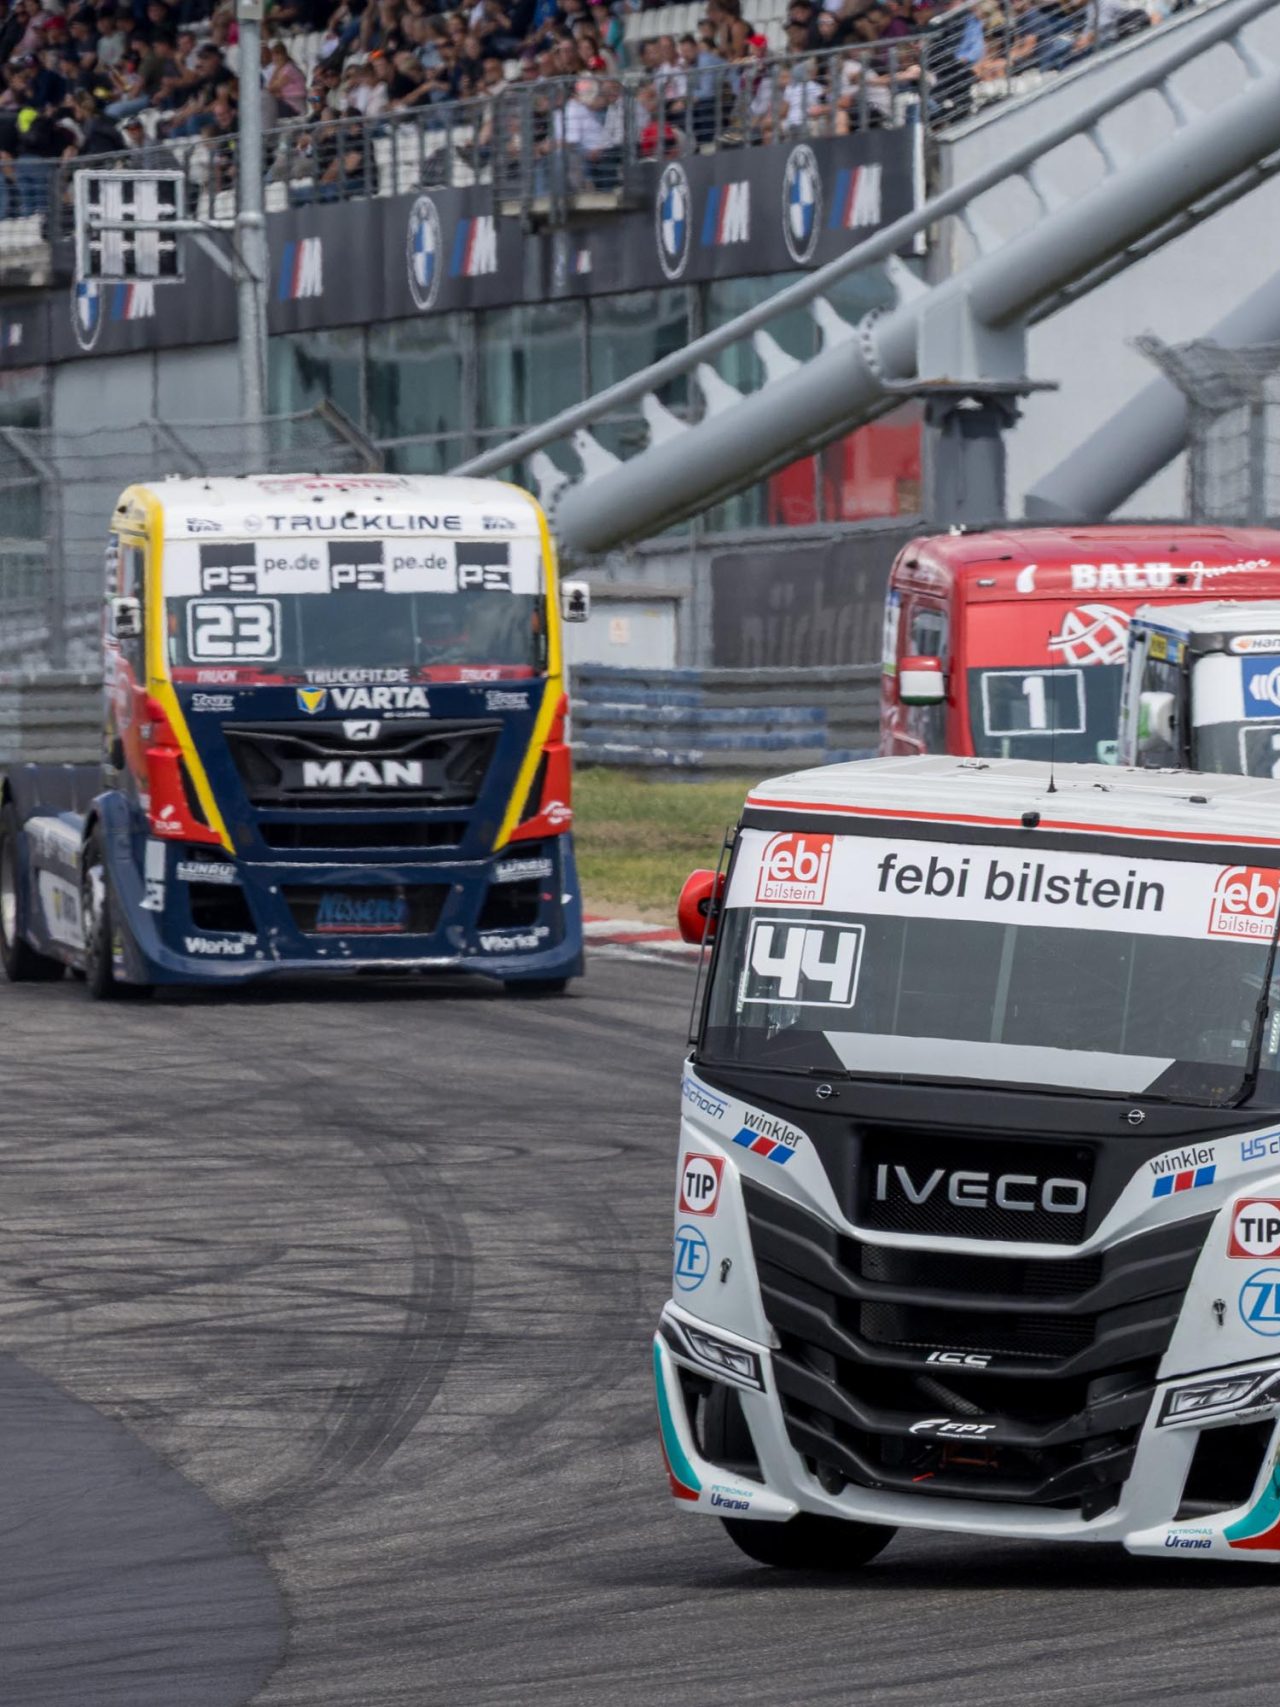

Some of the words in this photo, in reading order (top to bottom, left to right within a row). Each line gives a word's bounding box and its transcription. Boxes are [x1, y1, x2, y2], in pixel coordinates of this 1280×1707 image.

[267, 515, 462, 531] TRUCKLINE
[264, 554, 320, 574] pe.de
[393, 554, 447, 573] pe.de
[1070, 563, 1172, 590] BALU
[196, 605, 272, 655] 23
[330, 686, 430, 710] VARTA
[1023, 676, 1047, 730] 1
[303, 761, 423, 787] MAN
[761, 833, 832, 884] febi
[764, 883, 816, 900] bilstein
[877, 852, 972, 900] febi
[985, 859, 1166, 912] bilstein
[1218, 915, 1274, 935] bilstein
[752, 925, 857, 1002] 44
[743, 1111, 803, 1149] winkler
[1150, 1147, 1216, 1175] winkler
[684, 1170, 716, 1200] TIP
[876, 1163, 1087, 1214] IVECO
[926, 1351, 992, 1366] ICC
[939, 1423, 996, 1434] FPT
[711, 1484, 753, 1497] PETRONAS
[711, 1493, 750, 1510] Urania
[1165, 1535, 1212, 1549] Urania
[1167, 1528, 1213, 1536] PETRONAS
